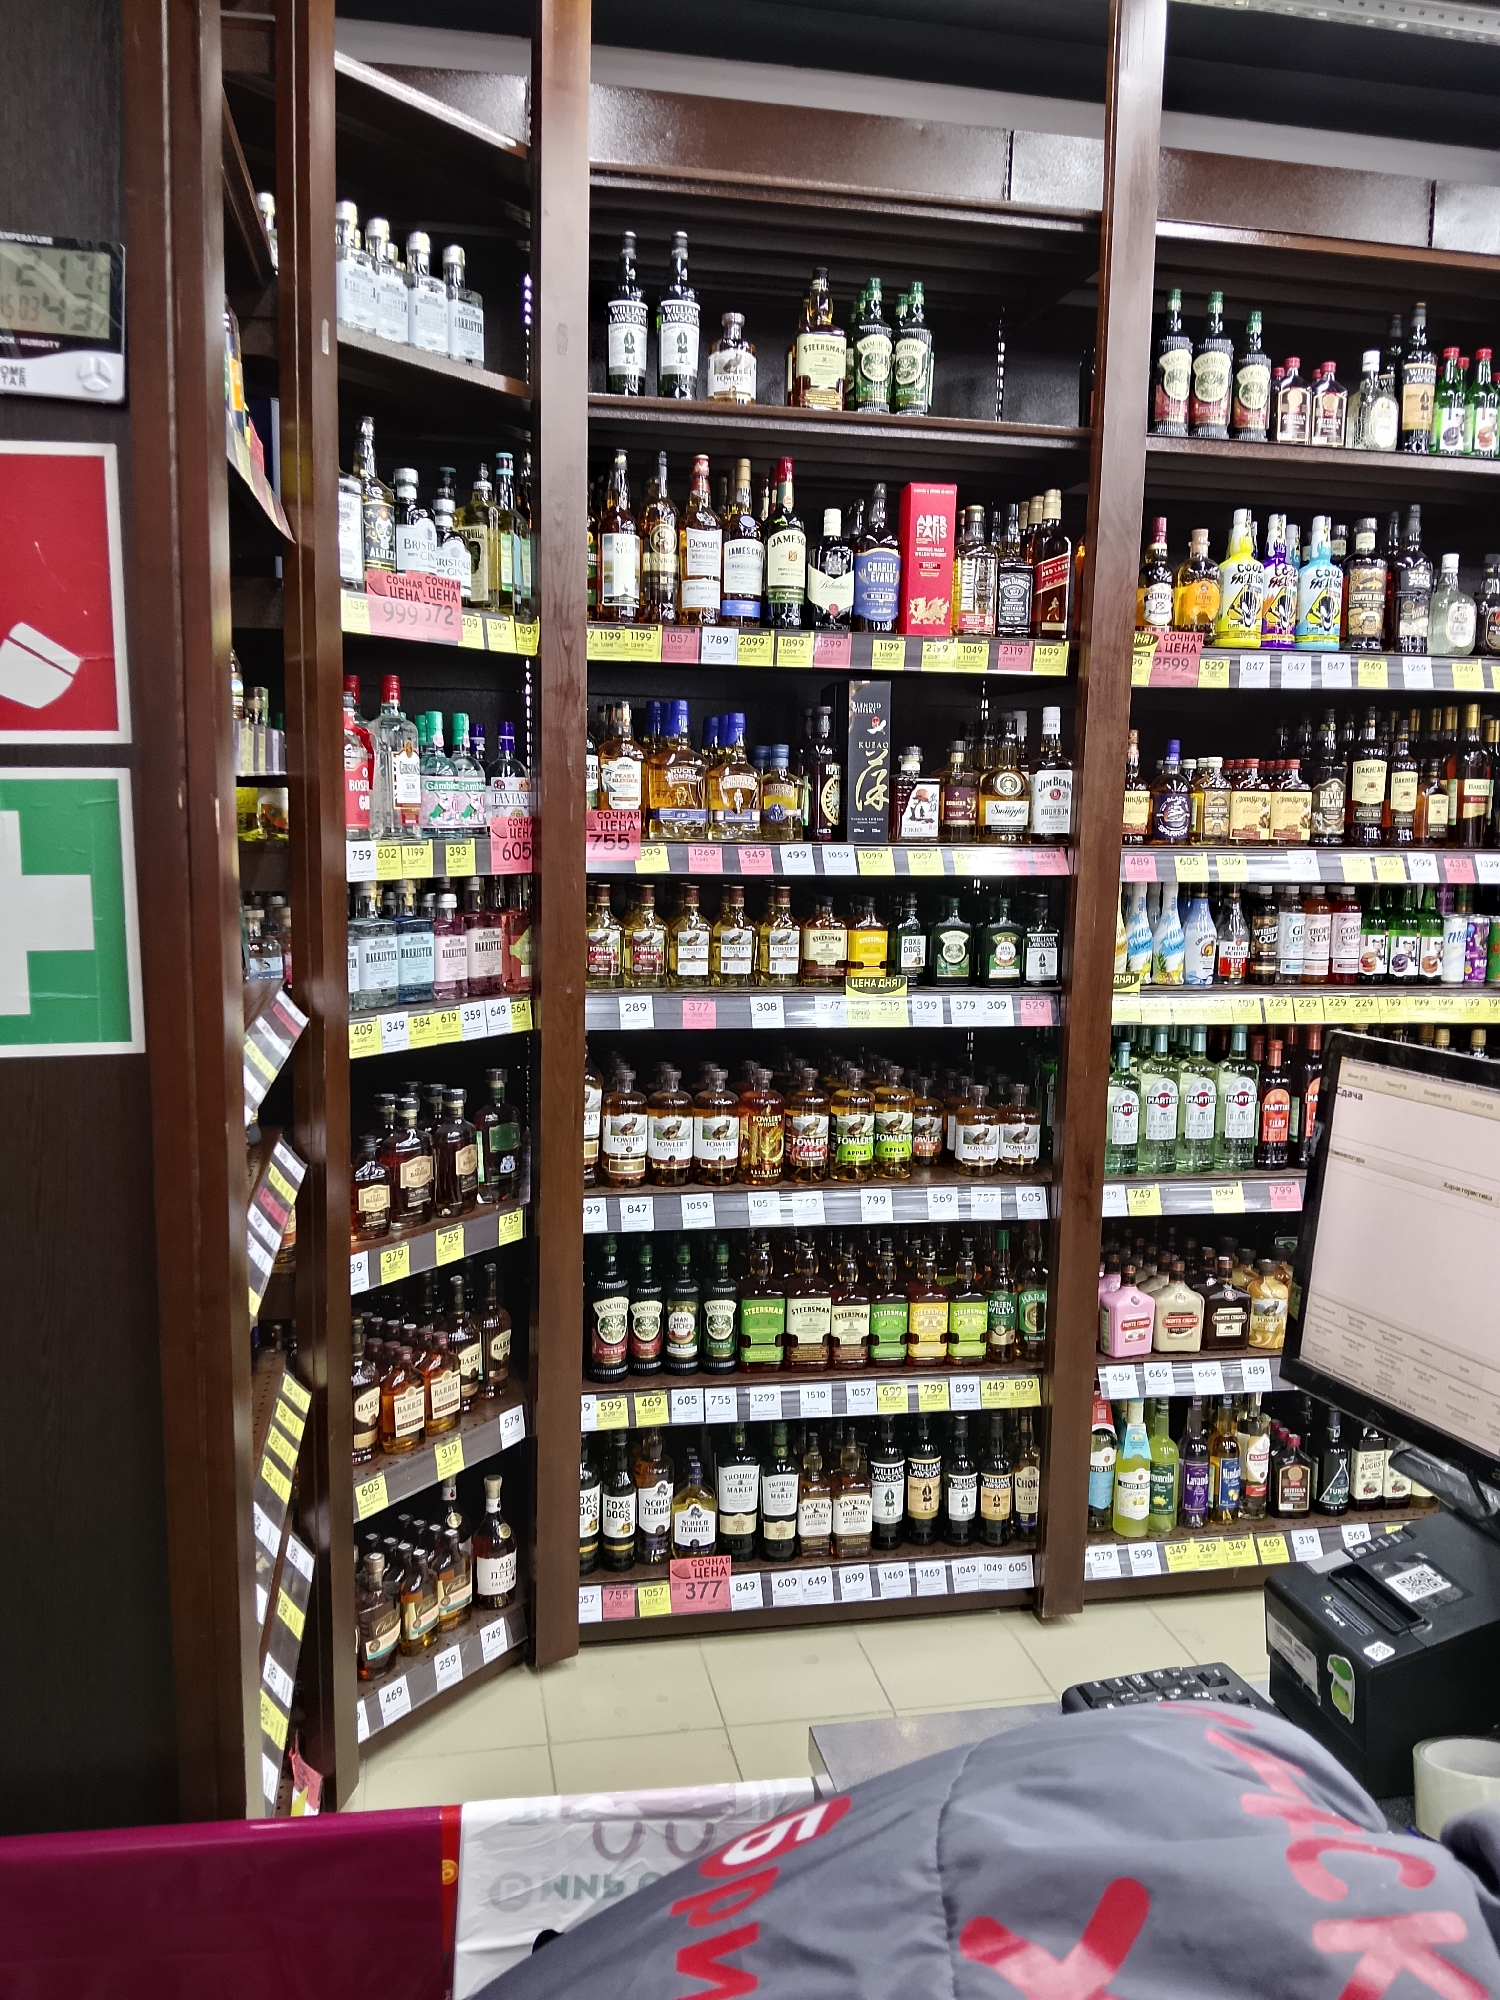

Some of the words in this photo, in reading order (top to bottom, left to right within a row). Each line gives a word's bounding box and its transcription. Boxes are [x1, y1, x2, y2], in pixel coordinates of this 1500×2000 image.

[611, 306, 647, 316] WILLIAM
[664, 306, 699, 316] WILLIAM
[803, 344, 846, 356] STEERSMAN
[1, 376, 27, 387] TAR
[916, 515, 947, 527] ABER
[867, 561, 896, 573] CHARLIE
[1237, 563, 1263, 573] COOL
[869, 571, 894, 583] EVANS
[1275, 568, 1297, 577] COOL
[1315, 569, 1341, 578] COOL
[386, 575, 423, 590] СОЧНАЯ
[424, 575, 461, 590] СОЧНАЯ
[389, 586, 420, 603] ЦЕНА
[428, 588, 458, 603] ЦЕНА
[382, 600, 418, 625] 999
[599, 630, 621, 641] 1199
[630, 631, 652, 641] 1199
[666, 634, 689, 643] 1057
[706, 634, 729, 644] 1789
[1163, 633, 1203, 643] СОЧНАЯ
[739, 637, 765, 647] 2099
[782, 638, 804, 648] 1899
[879, 642, 900, 651] 1199
[962, 645, 983, 654] 1049
[1003, 647, 1023, 656] 2119
[1038, 647, 1059, 657] 1499
[1165, 643, 1197, 654] ЦЕНА
[1204, 661, 1224, 670] 529
[1166, 796, 1186, 806] BLACK
[596, 811, 640, 821] СОЧНАЯ
[600, 820, 636, 832] ЦЕНА
[588, 833, 630, 851] 755
[352, 850, 371, 861] 759
[377, 848, 397, 859] 602
[406, 847, 424, 857] 1199
[449, 846, 467, 857] 393
[502, 841, 532, 860] 605
[693, 848, 716, 857] 1269
[744, 850, 765, 859] 949
[787, 850, 807, 859] 499
[1130, 857, 1149, 865] 489
[1449, 859, 1467, 868] 438
[904, 938, 921, 946] FOX&
[851, 978, 877, 988] ЦЕНА
[877, 978, 902, 989] ДНЯ!
[625, 1003, 647, 1012] 289
[688, 1002, 709, 1012] 377
[756, 1002, 777, 1011] 308
[916, 1001, 937, 1010] 399
[955, 1001, 976, 1011] 379
[986, 1001, 1007, 1010] 309
[1025, 1001, 1045, 1010] 529
[1269, 999, 1288, 1007] 229
[1328, 998, 1347, 1007] 229
[1354, 999, 1373, 1007] 229
[1385, 998, 1401, 1007] 199
[490, 1005, 506, 1017] 649
[511, 1003, 526, 1014] 564
[440, 1013, 457, 1023] 619
[464, 1009, 481, 1021] 359
[386, 1020, 405, 1032] 349
[413, 1017, 430, 1028] 584
[353, 1024, 373, 1037] 409
[1227, 1094, 1256, 1103] MARTINI
[1337, 1086, 1364, 1101] Сдача
[1147, 1095, 1178, 1104] MARTINI
[1113, 1104, 1139, 1113] MARTINI
[837, 1136, 873, 1145] FOWLER'S
[876, 1133, 912, 1142] FOWLER'S
[656, 1140, 687, 1148] FOWLER'S
[1133, 1190, 1151, 1199] 749
[1273, 1186, 1292, 1195] 799
[866, 1195, 886, 1205] 799
[932, 1193, 953, 1203] 569
[1021, 1193, 1041, 1202] 605
[627, 1204, 647, 1214] 847
[686, 1202, 708, 1210] 1059
[503, 1214, 519, 1225] 755
[442, 1232, 459, 1245] 759
[385, 1249, 404, 1263] 379
[989, 1300, 1012, 1308] GREEN
[743, 1307, 783, 1316] STEERSMAN
[792, 1306, 830, 1316] STEERSMAN
[988, 1306, 1015, 1315] WILLYS
[834, 1312, 868, 1320] STEERSMAN
[434, 1383, 459, 1397] BARREL
[924, 1384, 943, 1394] 799
[955, 1384, 975, 1393] 899
[986, 1382, 1005, 1391] 449
[1014, 1381, 1034, 1391] 899
[806, 1391, 826, 1399] 1510
[851, 1387, 871, 1397] 1057
[641, 1397, 662, 1408] 469
[677, 1396, 698, 1406] 605
[710, 1395, 731, 1406] 755
[754, 1394, 775, 1402] 1299
[397, 1399, 424, 1414] BARREL
[601, 1401, 622, 1411] 599
[504, 1414, 520, 1429] 579
[441, 1444, 458, 1459] 319
[873, 1465, 905, 1476] WILLIAM
[911, 1462, 942, 1473] WILLIAM
[1359, 1460, 1385, 1472] AUGUST
[724, 1473, 756, 1481] TROUBLE
[952, 1476, 977, 1486] WILLIAM
[984, 1476, 1010, 1484] WILLIAM
[361, 1481, 380, 1497] 605
[726, 1485, 753, 1494] MAKER
[606, 1499, 631, 1510] FOX&
[606, 1509, 631, 1519] DOGS
[681, 1519, 708, 1527] SCOTCH
[679, 1525, 710, 1533] TERRIER
[1298, 1535, 1315, 1545] 319
[1347, 1530, 1366, 1541] 569
[1199, 1542, 1217, 1553] 249
[1228, 1540, 1247, 1550] 349
[1262, 1538, 1281, 1548] 469
[1133, 1549, 1153, 1559] 599
[1168, 1544, 1187, 1554] 349
[1094, 1551, 1113, 1562] 579
[691, 1557, 731, 1567] СОЧНАЯ
[1008, 1562, 1027, 1572] 605
[956, 1565, 976, 1574] 1049
[983, 1563, 1003, 1572] 1049
[694, 1567, 727, 1579] ЦЕНА
[844, 1573, 865, 1583] 899
[884, 1571, 904, 1580] 1469
[920, 1568, 940, 1578] 1469
[777, 1578, 797, 1588] 609
[807, 1576, 827, 1586] 649
[685, 1580, 723, 1600] 377
[735, 1581, 756, 1592] 849
[608, 1590, 628, 1600] 755
[643, 1587, 664, 1597] 1057
[486, 1627, 502, 1643] 749
[438, 1655, 457, 1671] 259
[385, 1686, 403, 1704] 469
